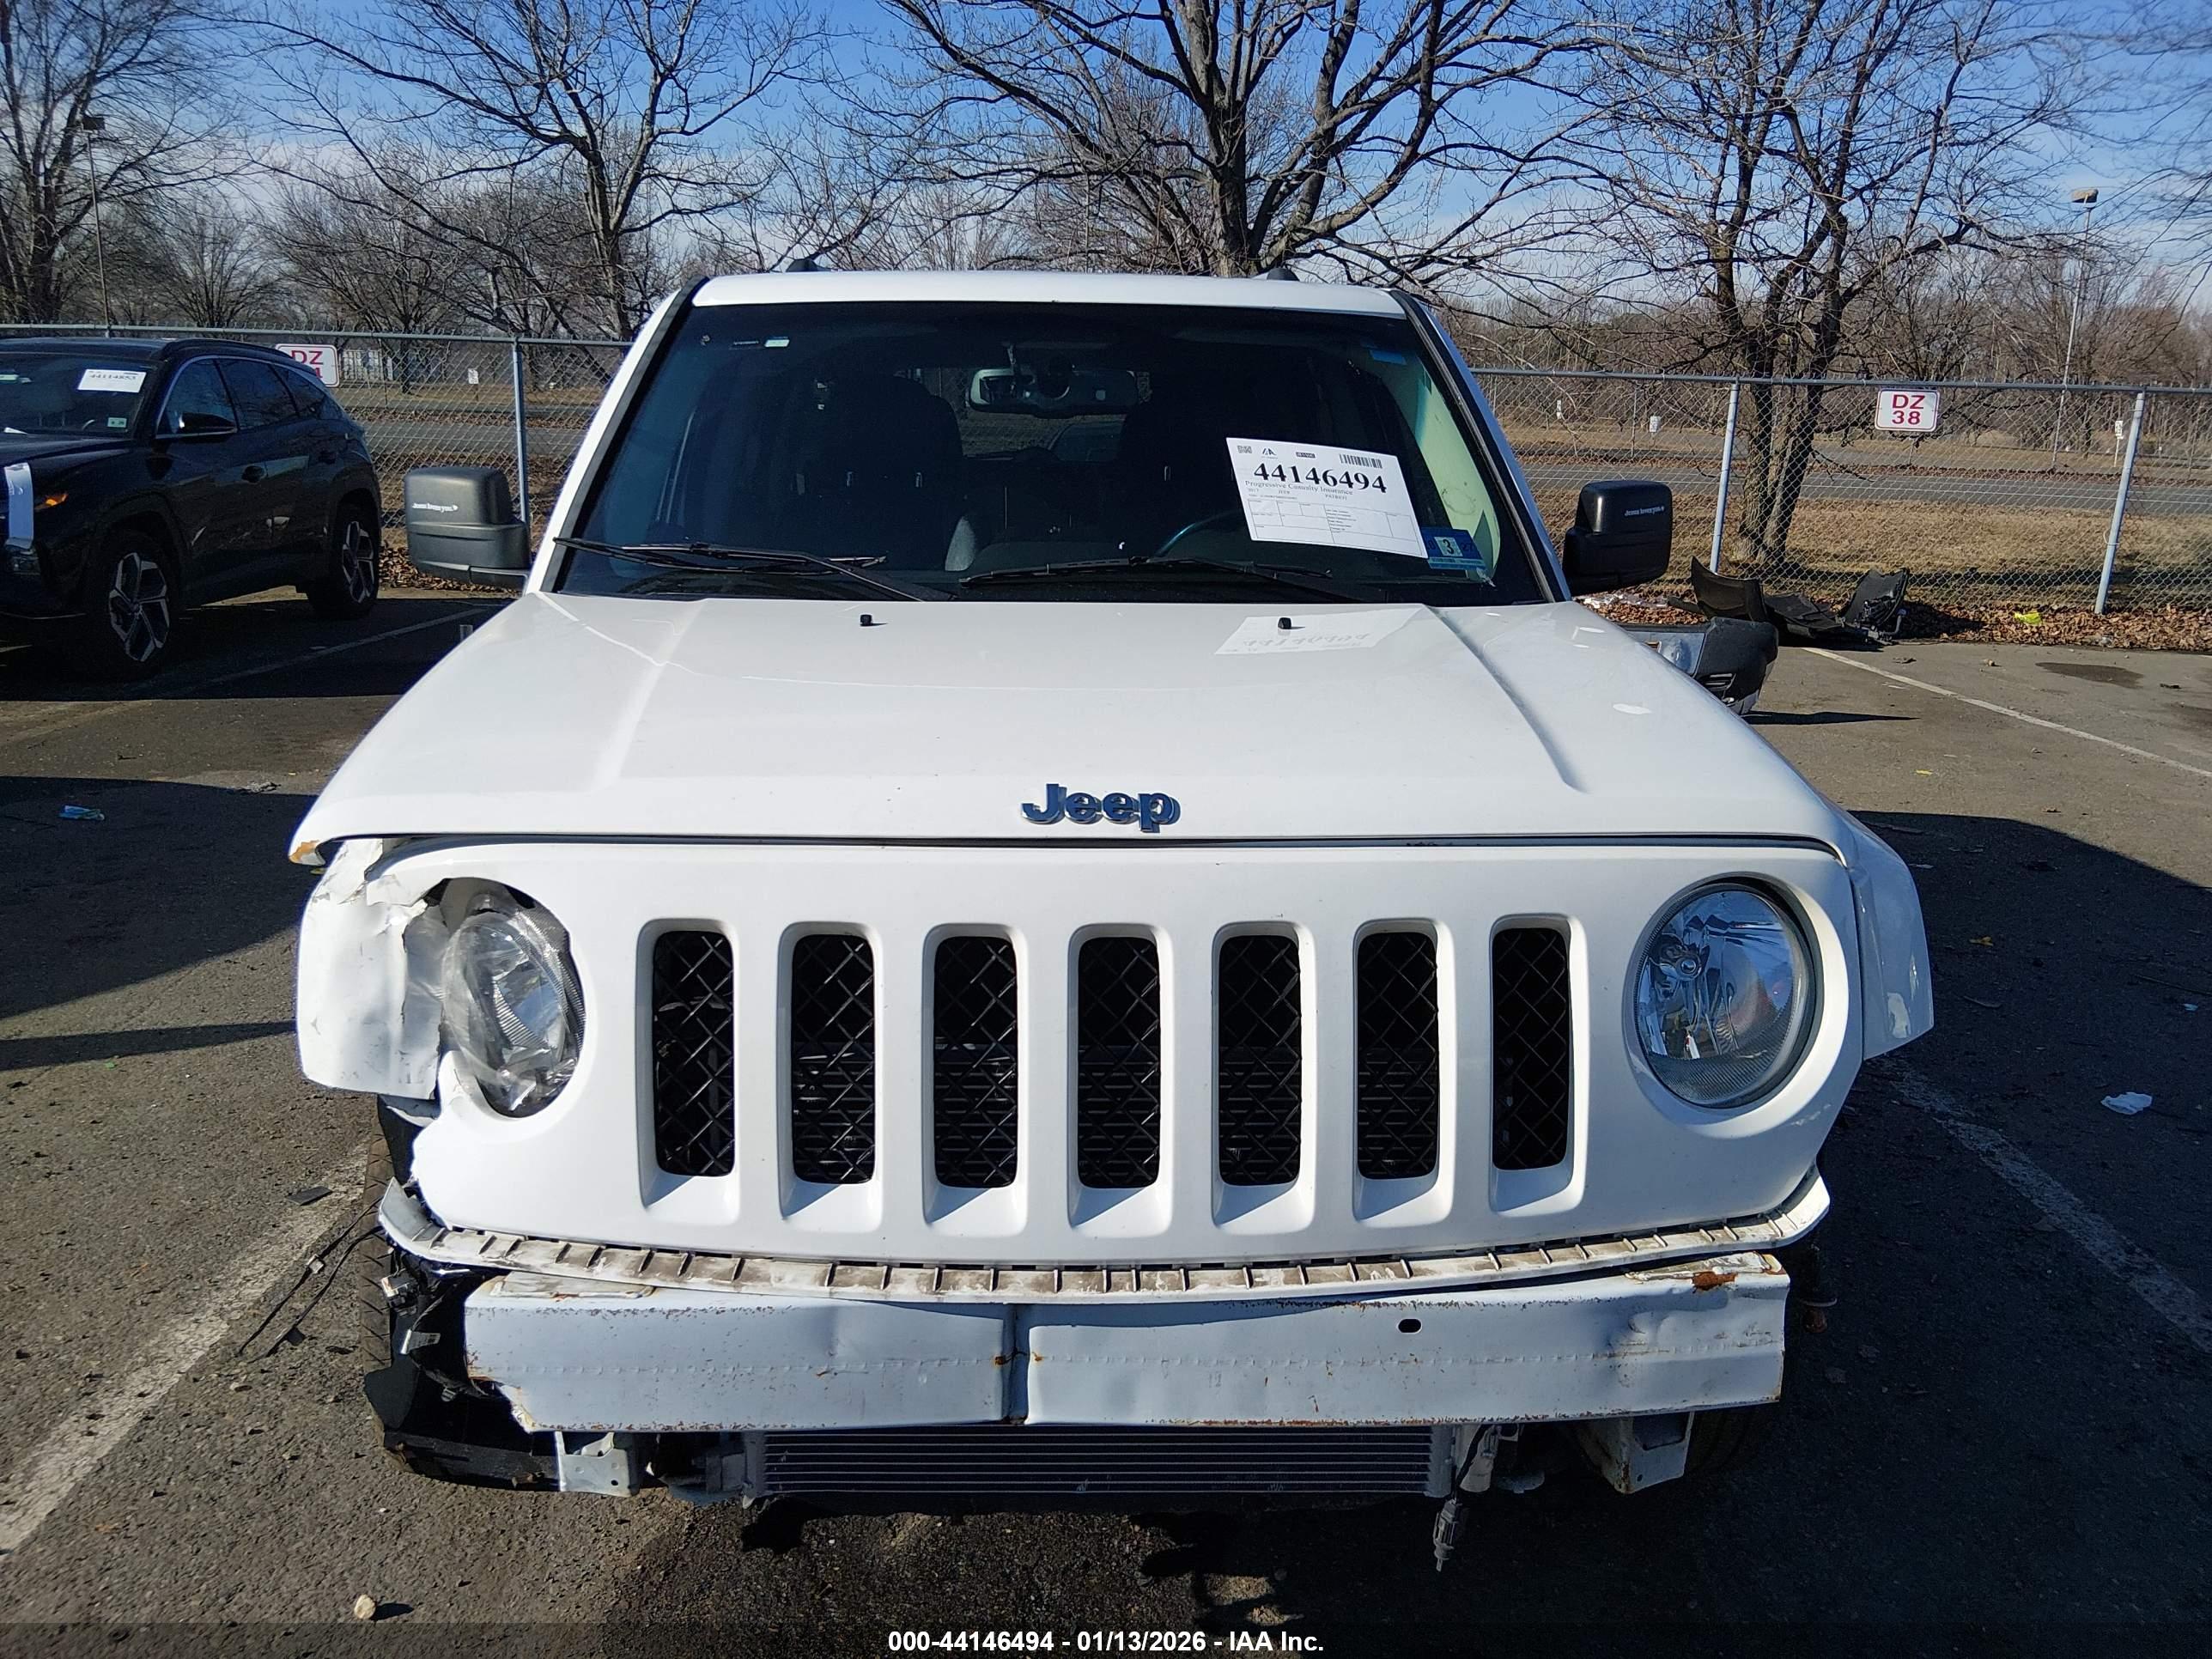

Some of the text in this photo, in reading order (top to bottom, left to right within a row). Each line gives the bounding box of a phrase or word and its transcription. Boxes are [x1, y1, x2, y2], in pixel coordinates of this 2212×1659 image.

[290, 349, 324, 365] DZ
[1892, 394, 1925, 410] DZ
[1892, 410, 1921, 425] 38
[1254, 463, 1387, 494] 44146494
[1245, 480, 1353, 495] Progressive Casualty Insurance
[1442, 538, 1455, 555] 3
[1021, 783, 1181, 833] Jeep
